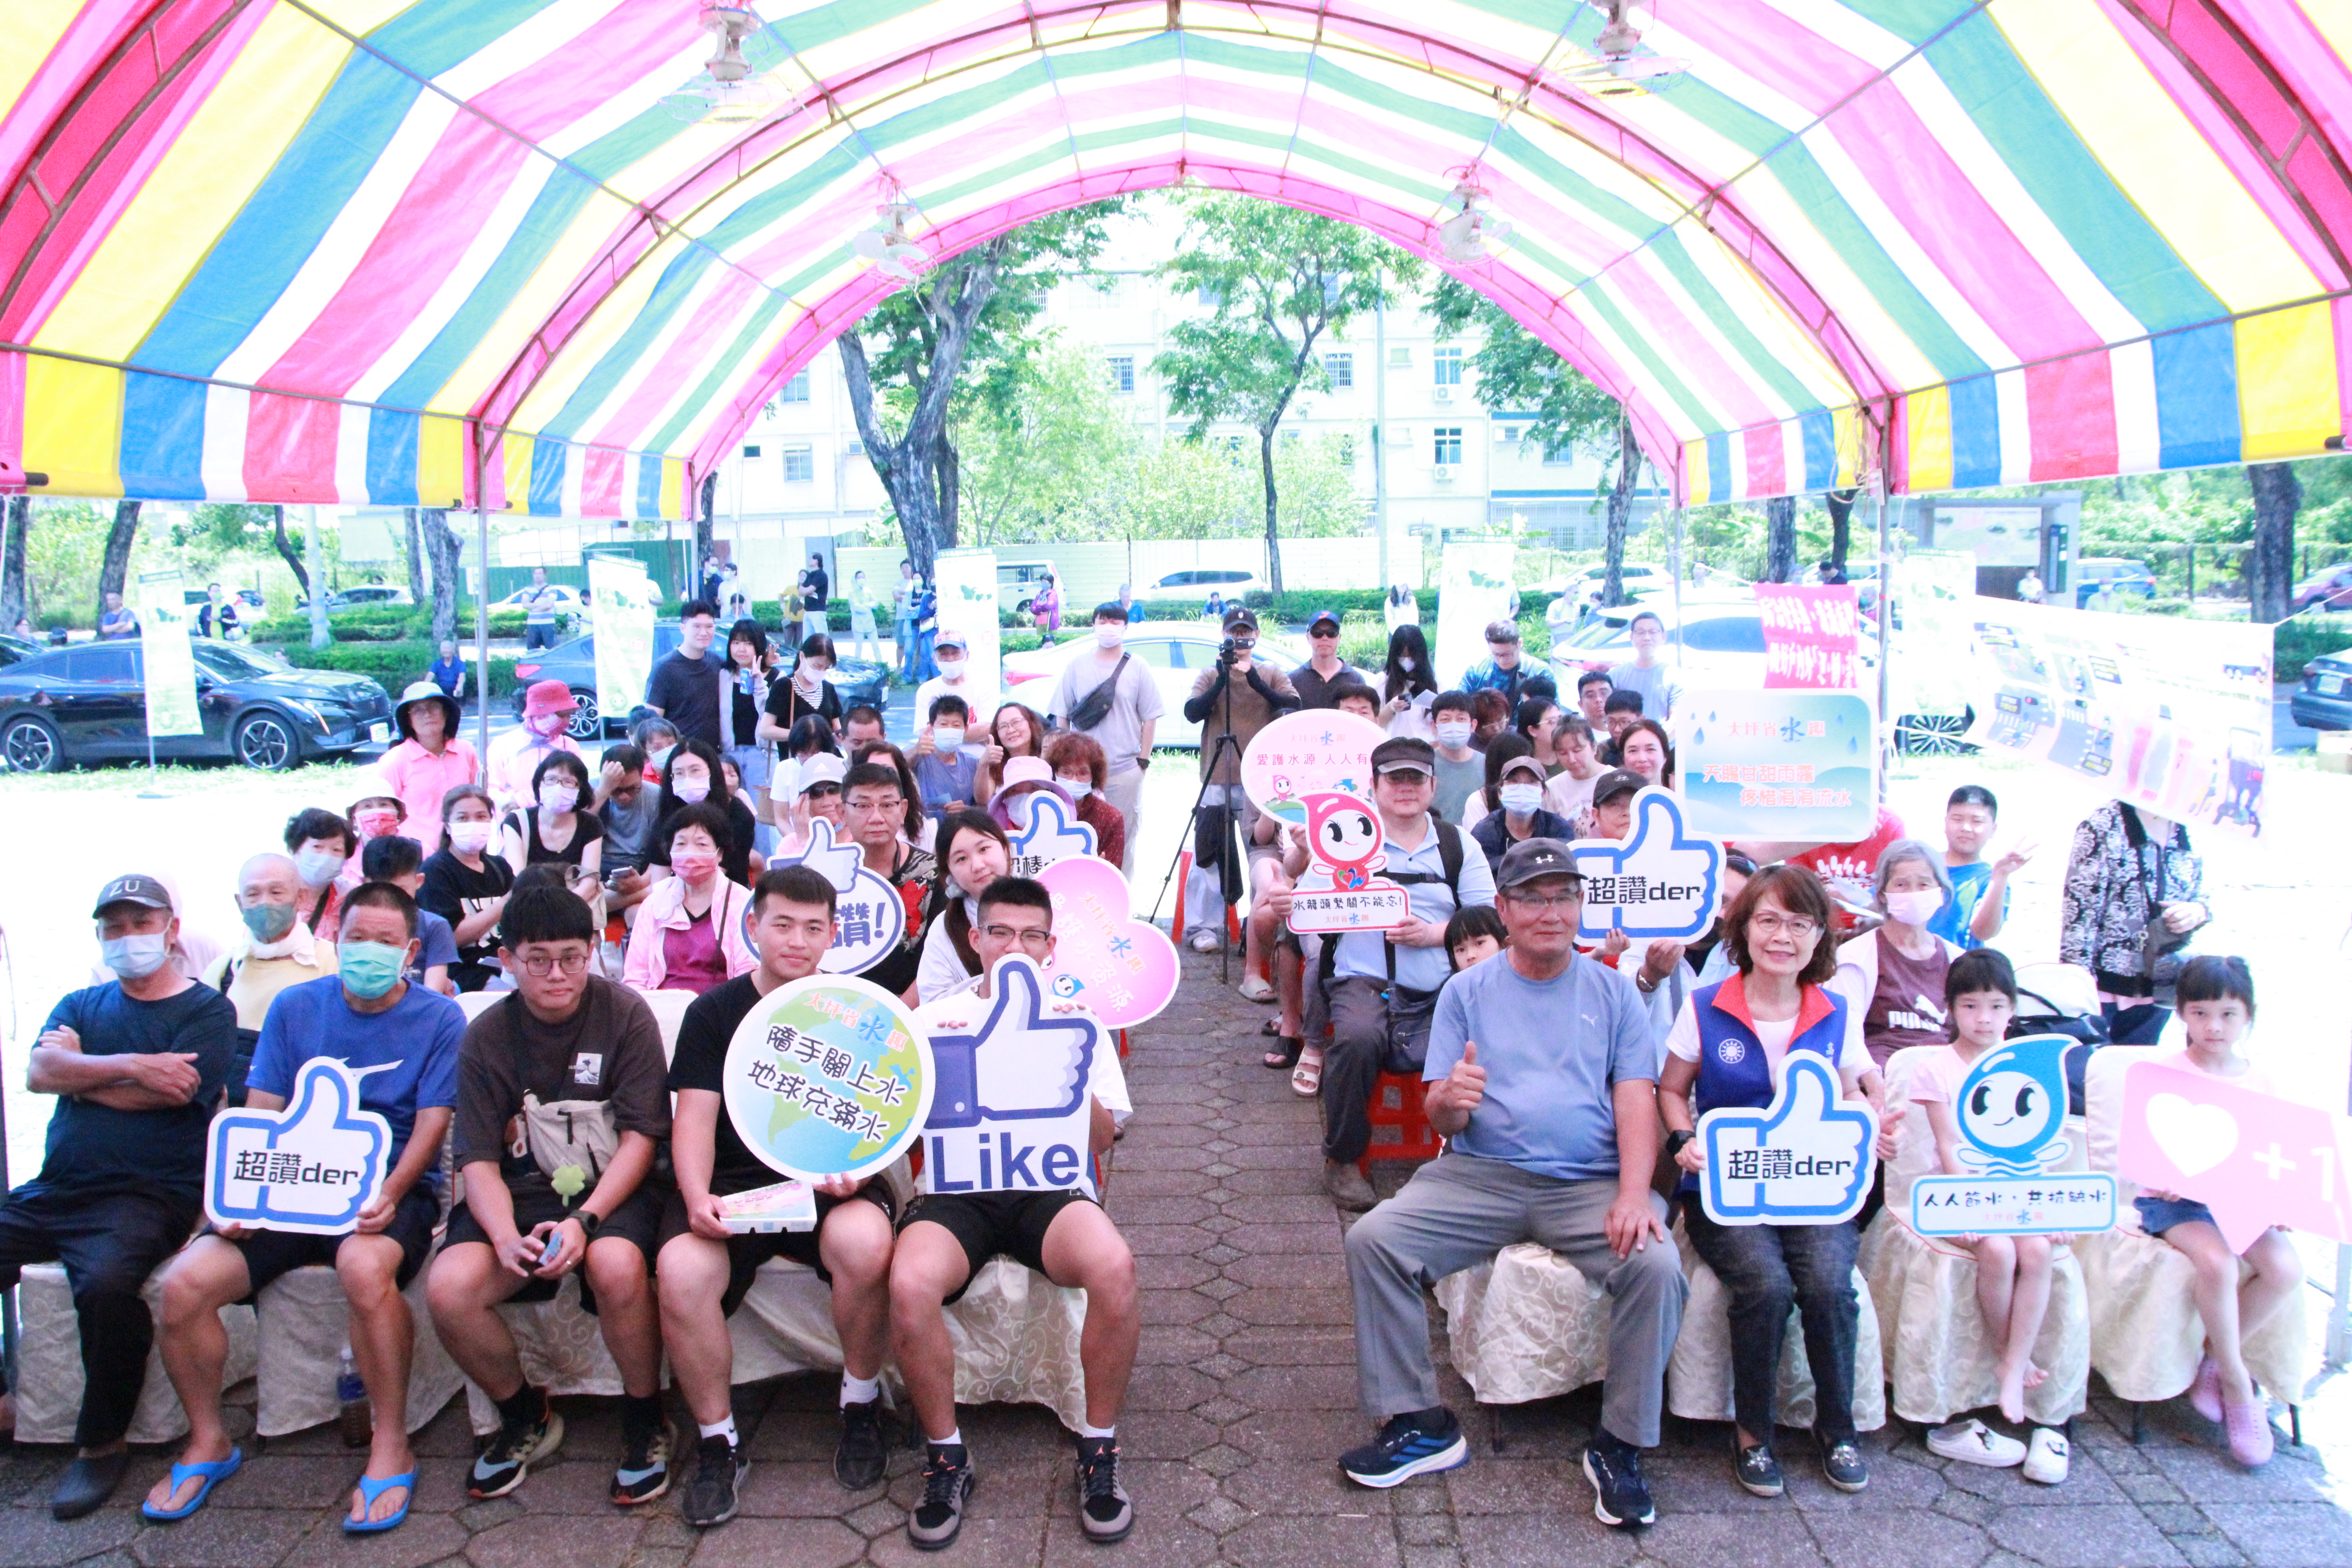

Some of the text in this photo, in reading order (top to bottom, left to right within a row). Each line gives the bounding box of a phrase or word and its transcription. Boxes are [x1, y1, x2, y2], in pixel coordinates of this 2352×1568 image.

[1257, 754, 1315, 766] 愛護水源
[1703, 765, 1815, 783] 天賜甘甜雨露
[1740, 789, 1852, 807] 疼惜涓涓流水
[109, 880, 141, 897] ZU
[1588, 876, 1700, 905] 超讚der
[767, 1026, 908, 1106] 隨手關上水
[748, 1060, 890, 1143] 地球充滿水
[233, 1150, 359, 1185] 超讚der
[931, 1133, 1078, 1192] Like
[1728, 1149, 1850, 1180] 超讚der
